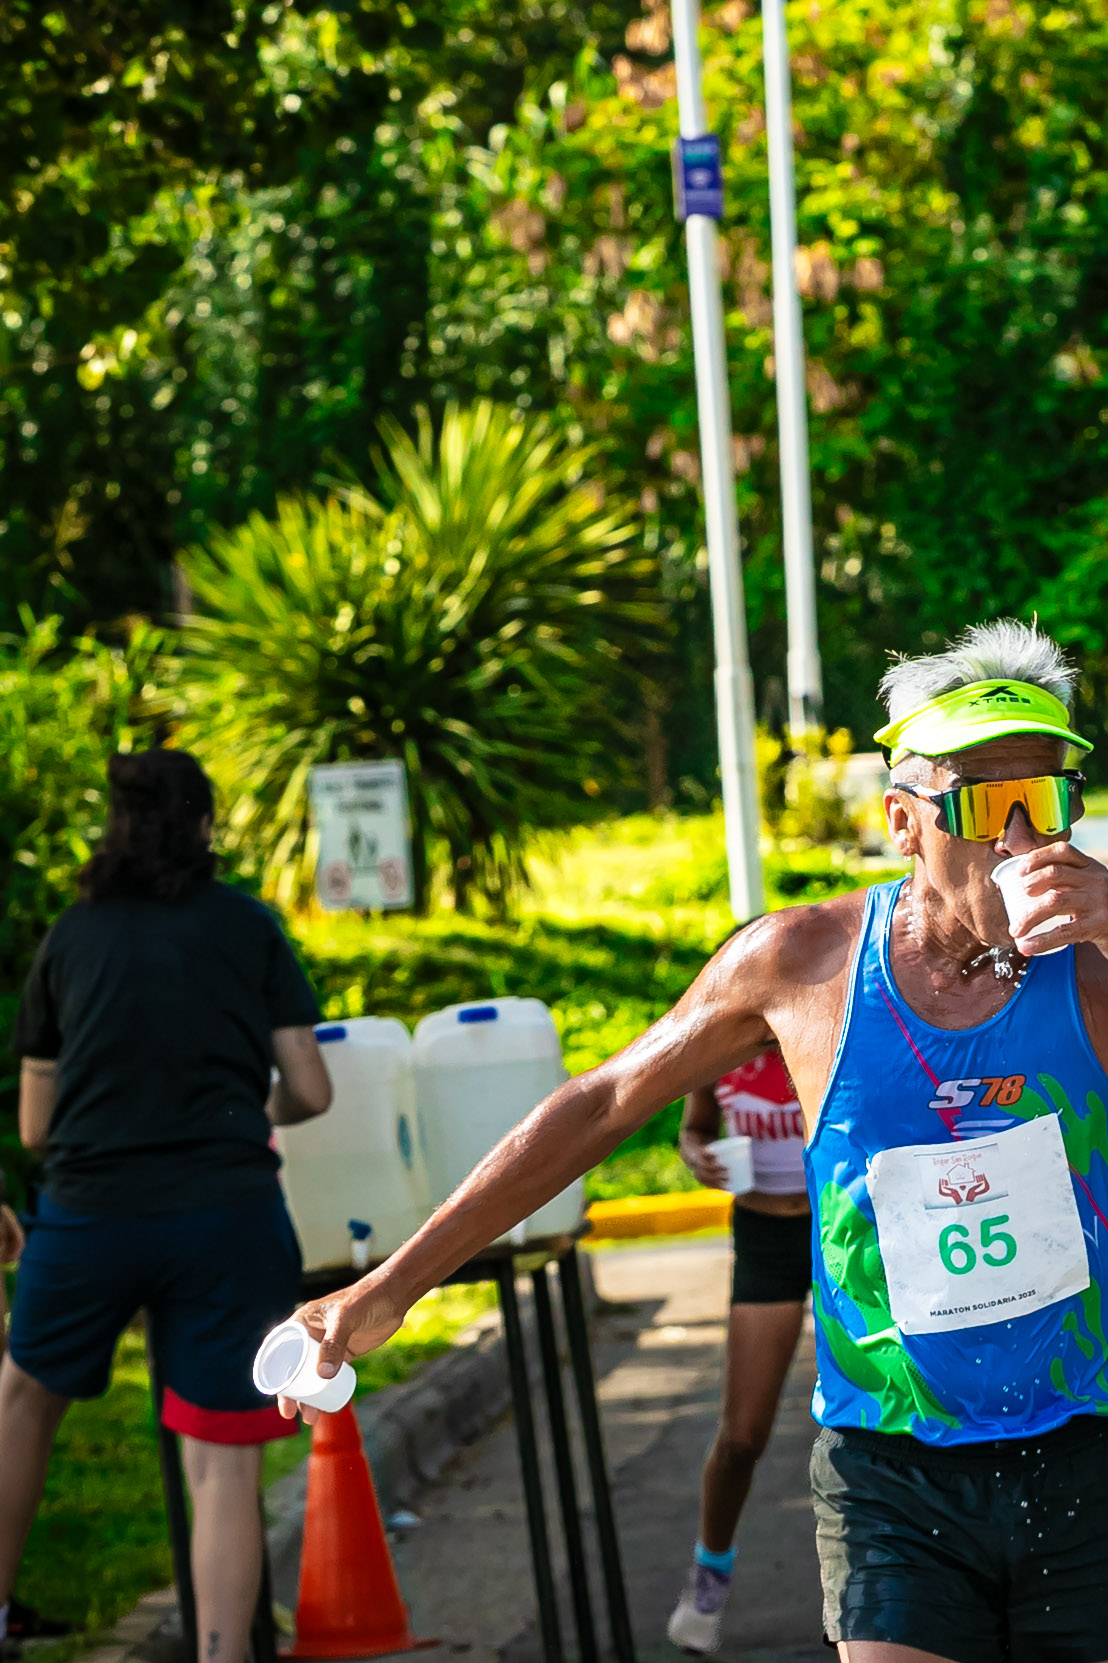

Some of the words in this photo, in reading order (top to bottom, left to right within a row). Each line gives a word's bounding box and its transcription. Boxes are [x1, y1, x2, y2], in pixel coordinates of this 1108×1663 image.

[928, 1074, 1026, 1109] S78
[938, 1214, 1018, 1276] 65
[930, 1305, 971, 1317] MARATON
[972, 1295, 1017, 1311] SOLIDARIA
[1018, 1289, 1037, 1300] 2025
